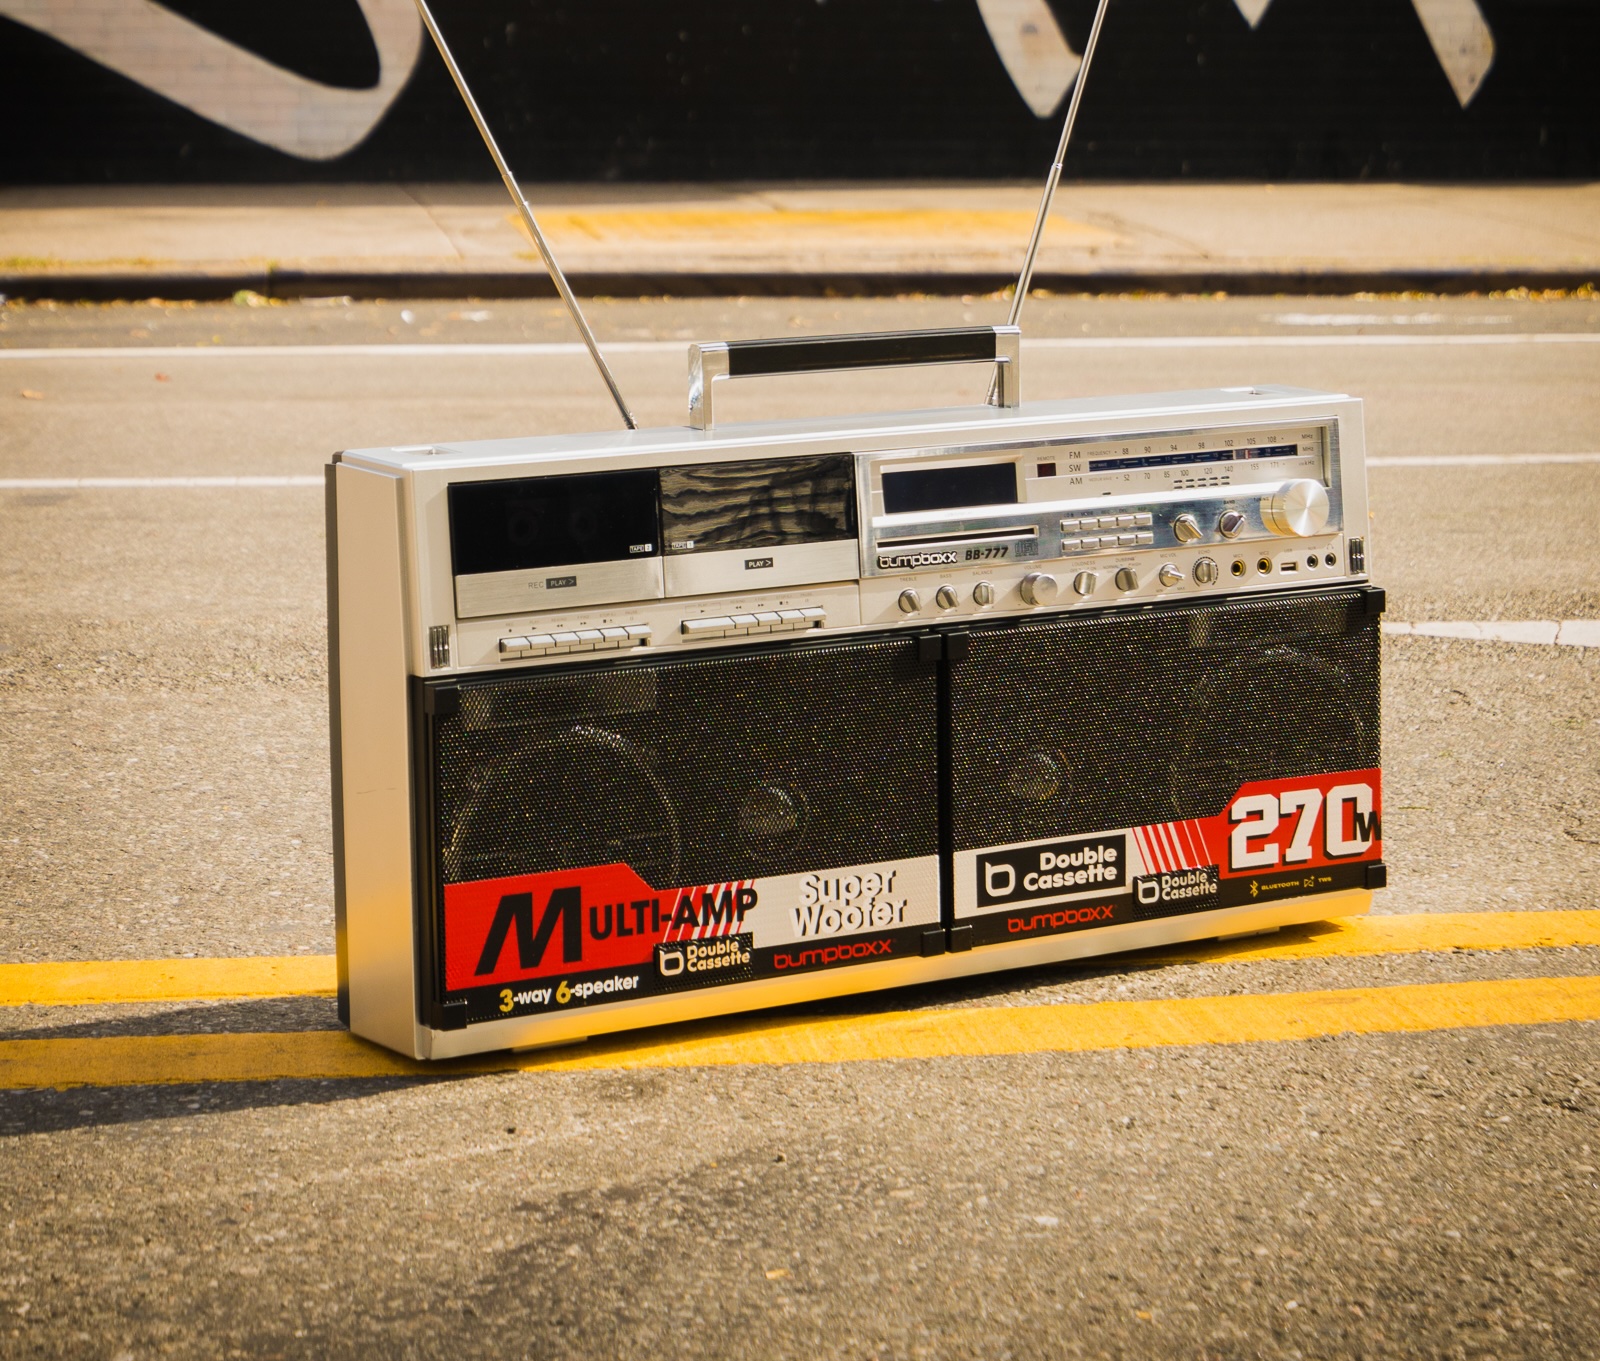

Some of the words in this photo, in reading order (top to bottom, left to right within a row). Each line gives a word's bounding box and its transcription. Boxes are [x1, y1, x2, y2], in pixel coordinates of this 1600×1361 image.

[1069, 451, 1081, 459] FM
[1144, 446, 1151, 454] 90
[1170, 444, 1178, 452] 94
[1198, 441, 1205, 449] 98
[1224, 439, 1233, 447] 102
[1247, 437, 1256, 445] 105
[1069, 477, 1083, 485] AM
[1144, 472, 1151, 480] 70
[1180, 469, 1189, 477] 100
[1204, 467, 1213, 475] 120
[1224, 465, 1233, 473] 140
[1250, 463, 1259, 471] 155
[1270, 461, 1279, 469] 171
[630, 545, 644, 553] TAPE
[672, 541, 687, 549] TAPE
[748, 560, 764, 568] PLAY
[878, 551, 958, 568] bumpboxx
[965, 547, 1009, 561] BB-777
[528, 581, 544, 589] REC
[551, 579, 567, 587] PLAY
[1040, 845, 1117, 870] Double
[799, 870, 896, 906] Super
[1023, 864, 1117, 891] Cassette
[1161, 871, 1208, 890] Double
[1261, 881, 1300, 890] BLUETOOTH
[1161, 882, 1218, 901] Cassette
[789, 897, 907, 937] Woofer
[1007, 904, 1114, 933] bumpboxx
[474, 886, 758, 977] MULTI-AMP
[687, 939, 739, 960] Double
[774, 939, 892, 969] bumpboxx
[687, 950, 751, 972] Cassette
[499, 988, 552, 1013] 3-way
[556, 975, 639, 1004] 6-speaker
